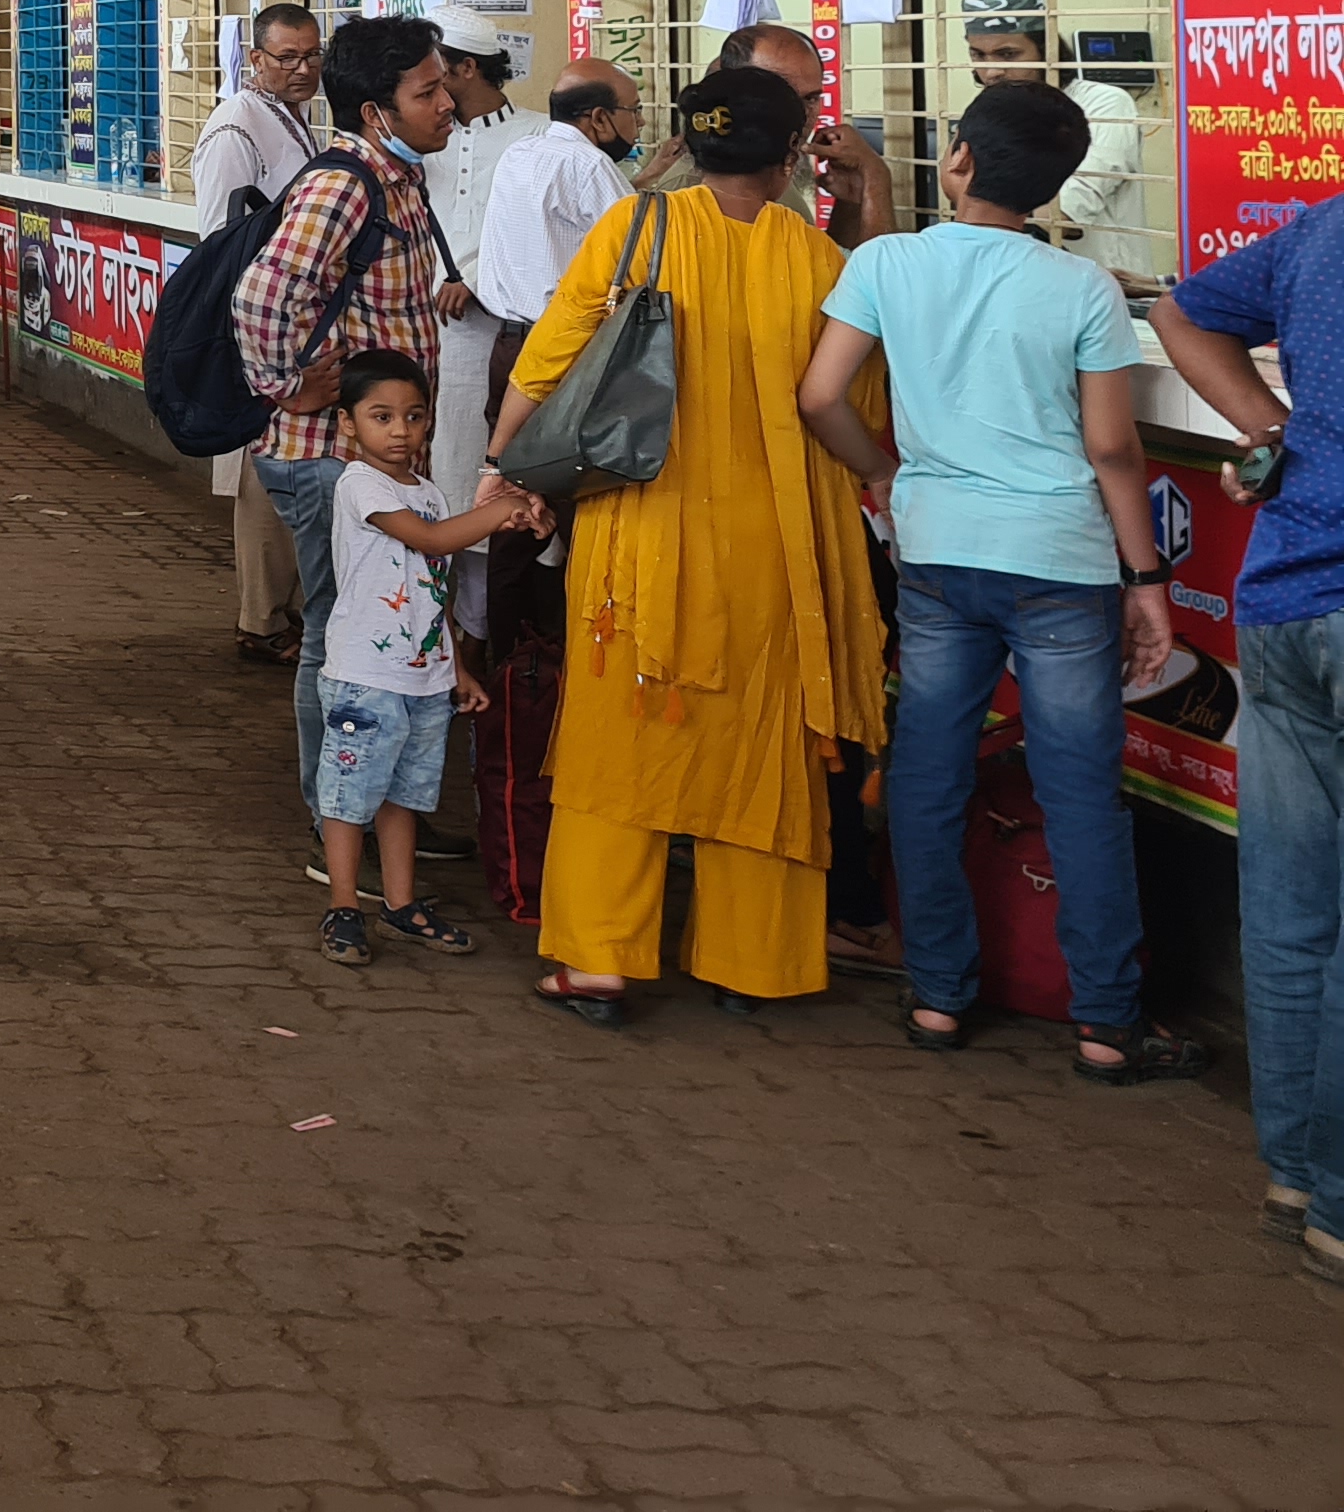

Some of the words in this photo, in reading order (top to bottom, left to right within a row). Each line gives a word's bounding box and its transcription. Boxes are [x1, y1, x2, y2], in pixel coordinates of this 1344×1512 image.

[51, 218, 97, 320] স্টার
[100, 223, 161, 350] লাইন
[1170, 581, 1227, 621] Group
